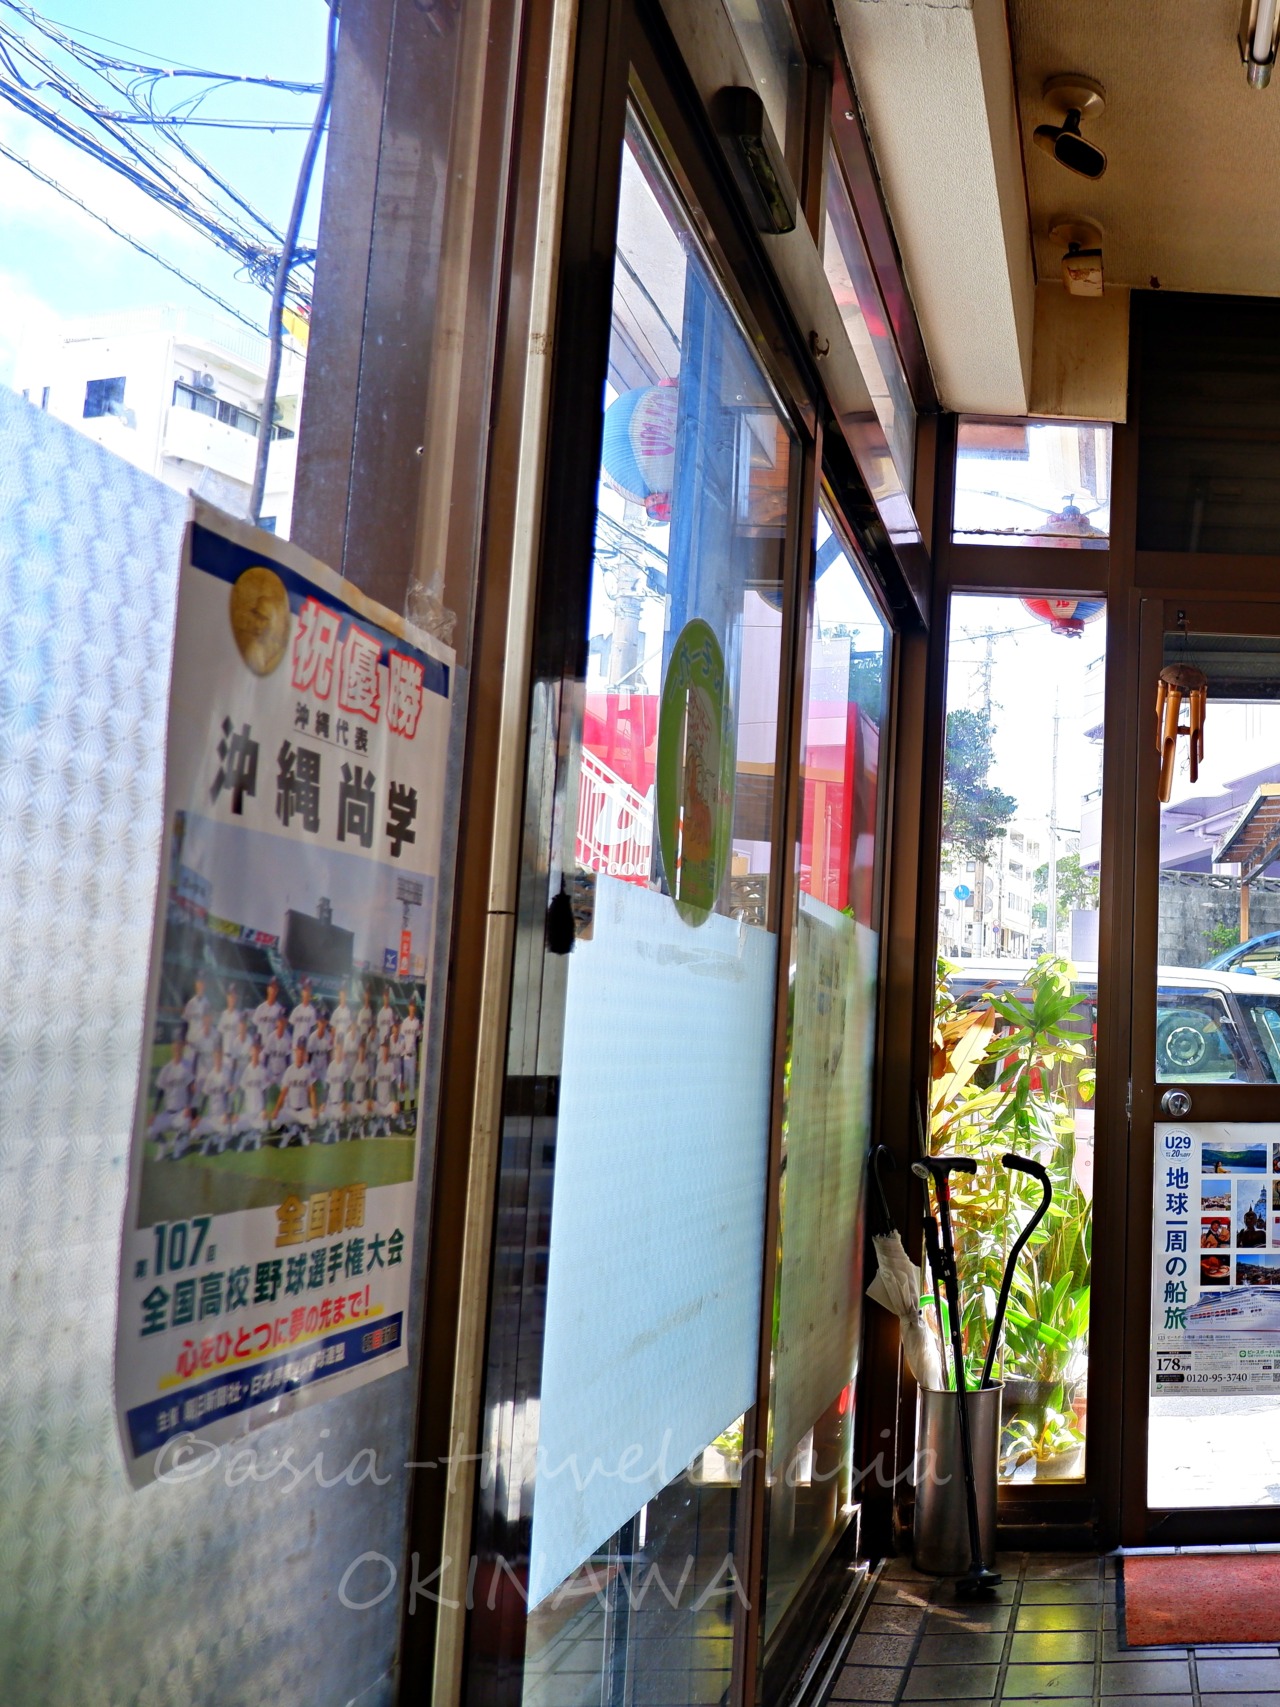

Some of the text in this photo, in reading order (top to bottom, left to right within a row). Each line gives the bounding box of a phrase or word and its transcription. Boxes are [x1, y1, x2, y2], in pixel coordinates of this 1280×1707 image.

[291, 596, 425, 740] 祝優勝
[294, 701, 369, 753] 沖縄代表
[209, 714, 418, 858] 沖縄尚学
[1165, 1136, 1192, 1149] U29
[275, 1183, 368, 1248] 全国制覇
[1163, 1166, 1190, 1330] 地球一周の船旅
[141, 1227, 405, 1337] 全国高校野球選手権大会
[1156, 1358, 1192, 1371] 178万円
[1186, 1373, 1248, 1383] 0120-95-3740
